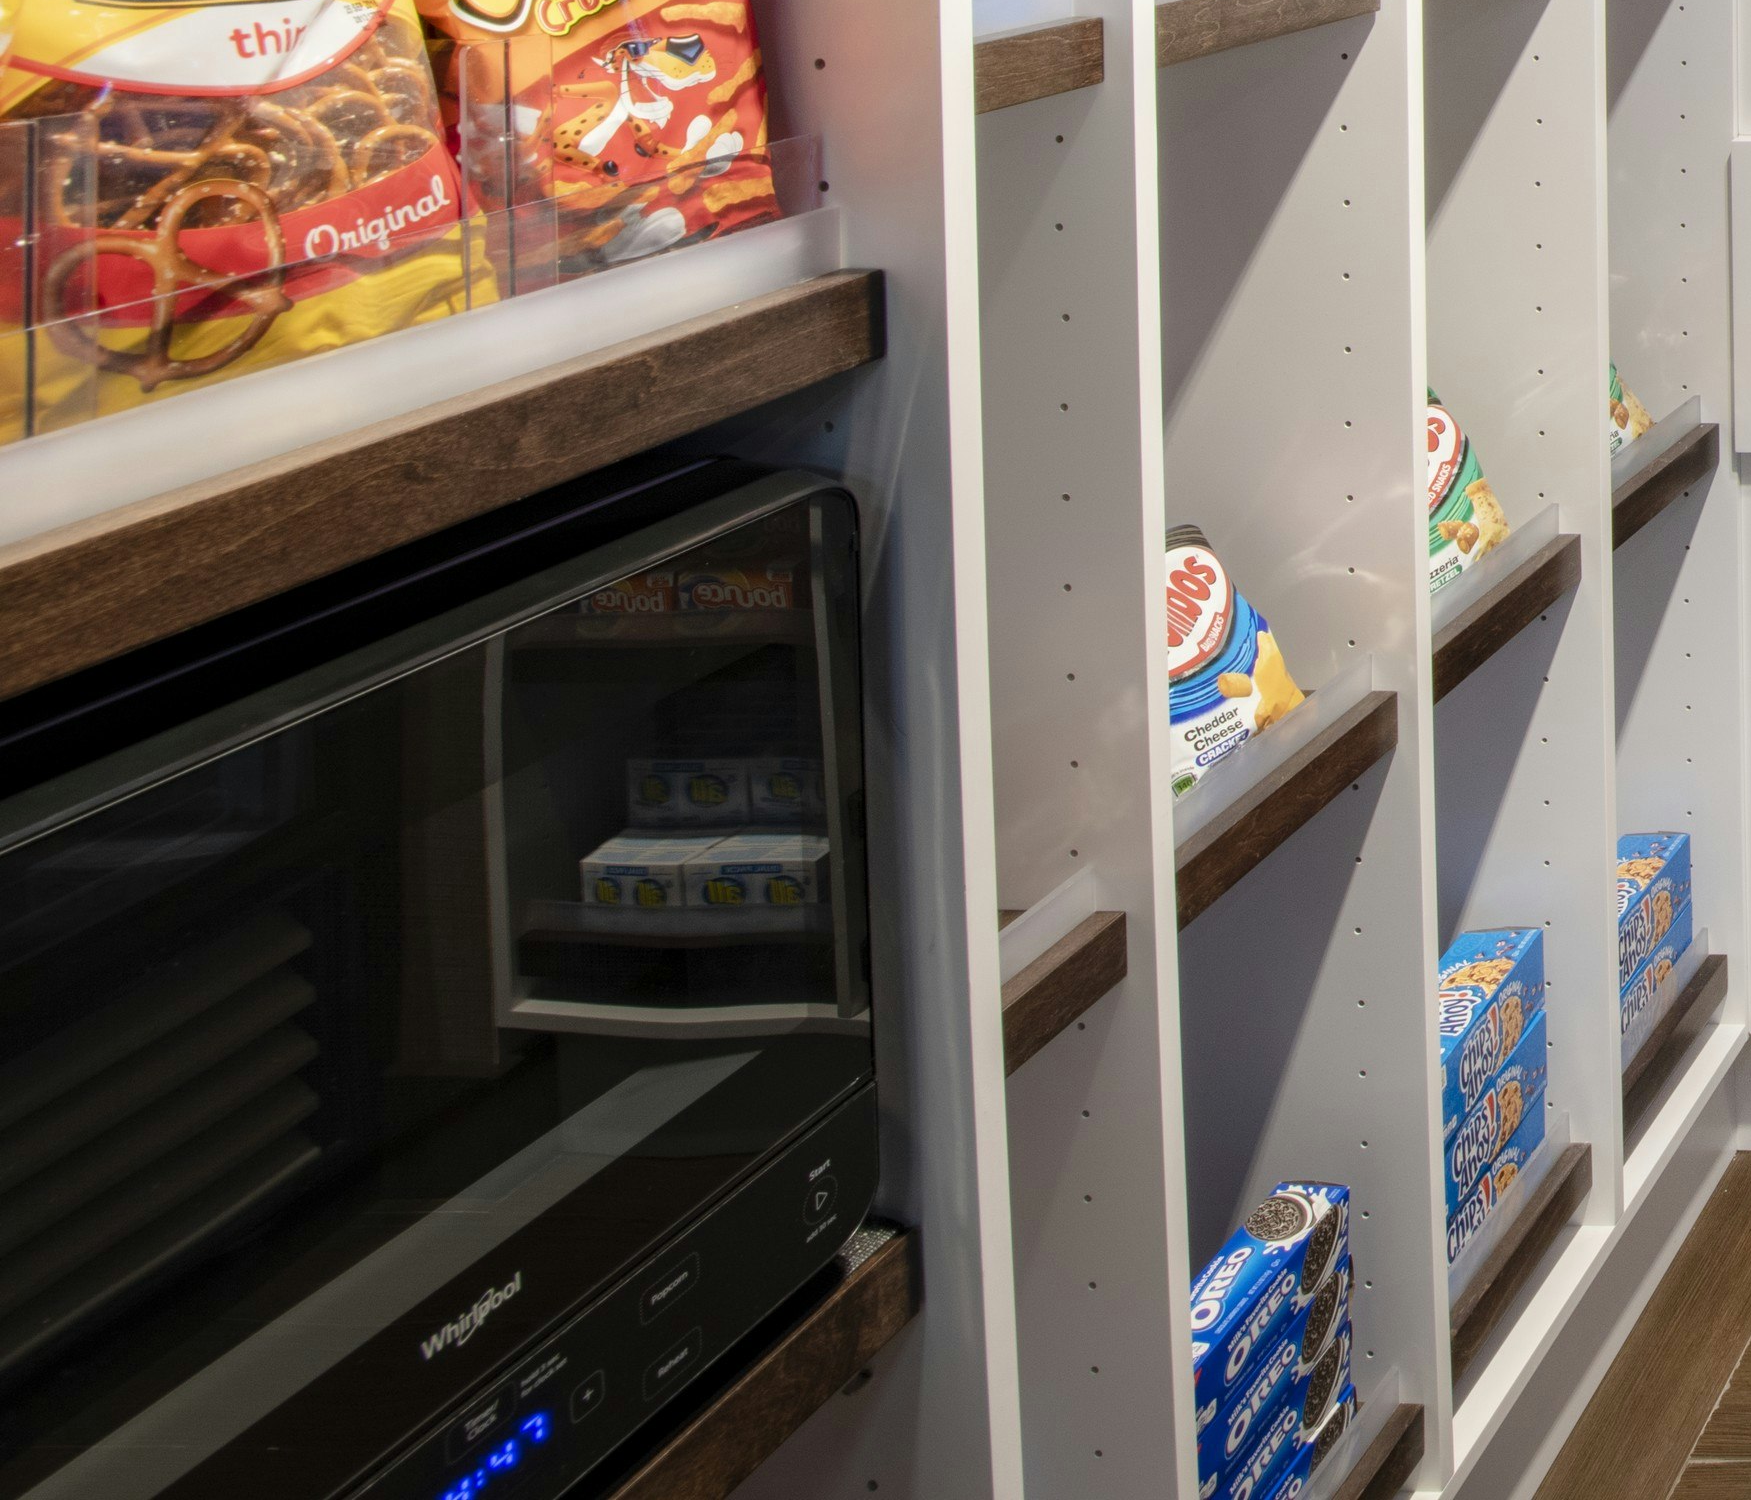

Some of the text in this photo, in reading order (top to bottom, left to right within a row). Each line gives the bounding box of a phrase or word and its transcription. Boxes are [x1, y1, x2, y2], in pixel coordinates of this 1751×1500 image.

[305, 175, 450, 259] Original
[1434, 464, 1450, 493] SNACKS
[1184, 707, 1239, 741] Cheddar
[1194, 719, 1244, 751] Cheese
[1619, 908, 1644, 967] Chips
[1621, 979, 1646, 1035] Chips
[1461, 1019, 1492, 1091] Chips
[1496, 1066, 1522, 1090] ORIGINAL
[809, 1159, 830, 1182] Start
[1453, 1104, 1488, 1180] Chips
[1491, 1147, 1520, 1174] ORIGINAL
[1447, 1187, 1483, 1264] Chips
[420, 1271, 521, 1360] Whirlpool
[651, 1271, 688, 1305] Popcorn
[1191, 1247, 1252, 1330] OREO
[1226, 1273, 1295, 1384] OREO
[1225, 1343, 1296, 1457] OREO
